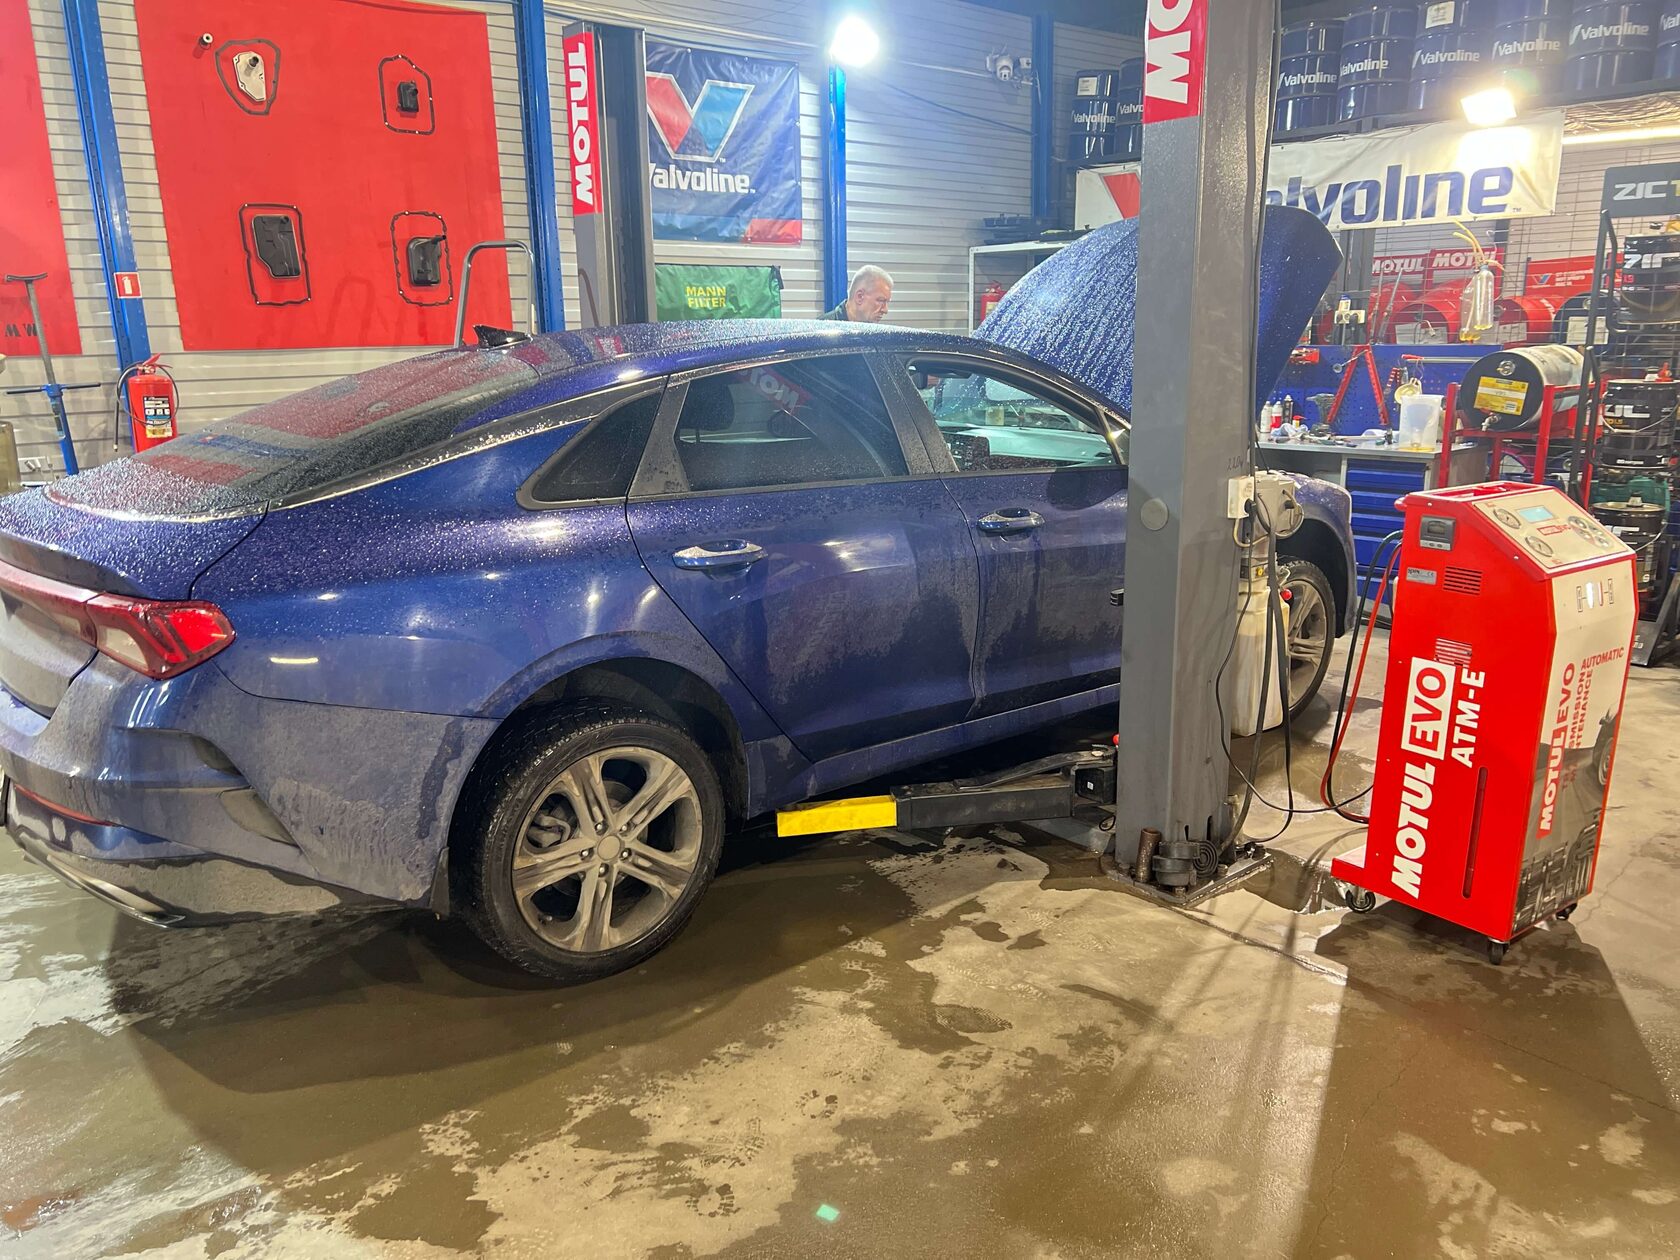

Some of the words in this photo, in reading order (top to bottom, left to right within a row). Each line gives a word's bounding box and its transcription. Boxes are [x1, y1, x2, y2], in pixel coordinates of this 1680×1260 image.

[1581, 22, 1650, 41] Valvoline
[1498, 38, 1561, 56] Valvoline
[1420, 49, 1480, 65] Valvoline
[1284, 71, 1338, 87] Valvoline
[568, 43, 594, 205] MOTUL
[1073, 112, 1116, 123] Valvoline
[1613, 180, 1668, 201] ZIC
[1371, 257, 1425, 274] MOTUL
[685, 286, 727, 297] MANN
[687, 297, 727, 309] FILTER
[1580, 647, 1625, 671] AUTOMATIC
[1408, 666, 1447, 752] EVO
[1451, 668, 1486, 768] ATM-E
[1539, 730, 1566, 831] MOTUL
[1556, 662, 1576, 725] EVO
[1391, 762, 1436, 899] MOTUL
